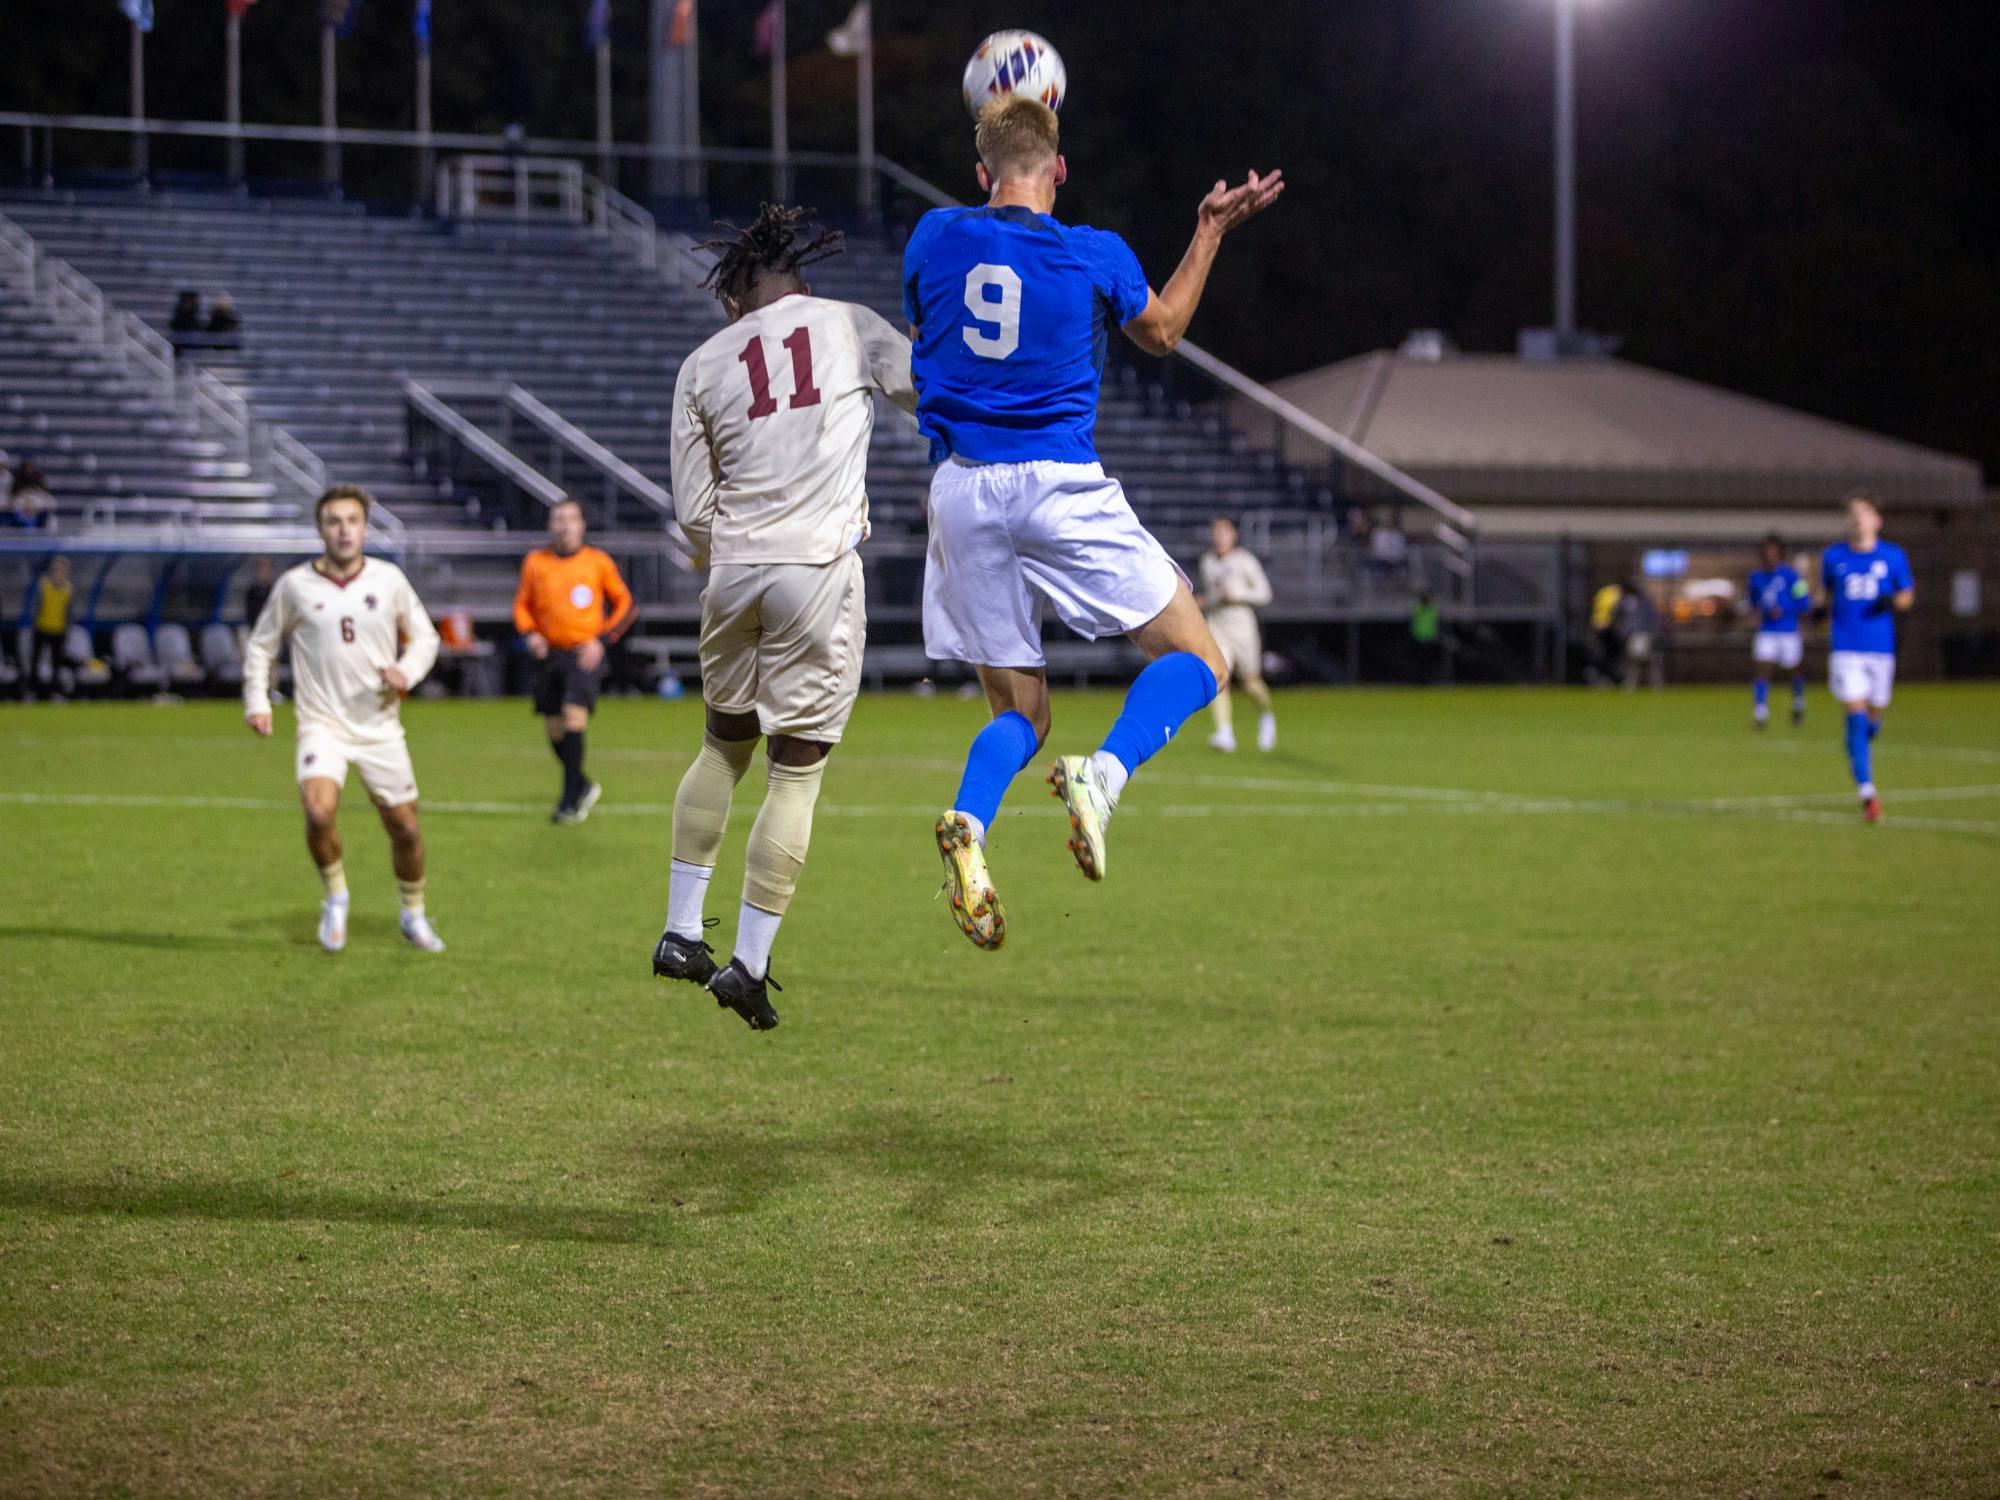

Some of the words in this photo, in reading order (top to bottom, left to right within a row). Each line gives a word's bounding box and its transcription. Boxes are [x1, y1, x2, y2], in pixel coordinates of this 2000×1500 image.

[963, 263, 1022, 360] 9
[738, 326, 821, 421] 11
[340, 616, 355, 644] 6
